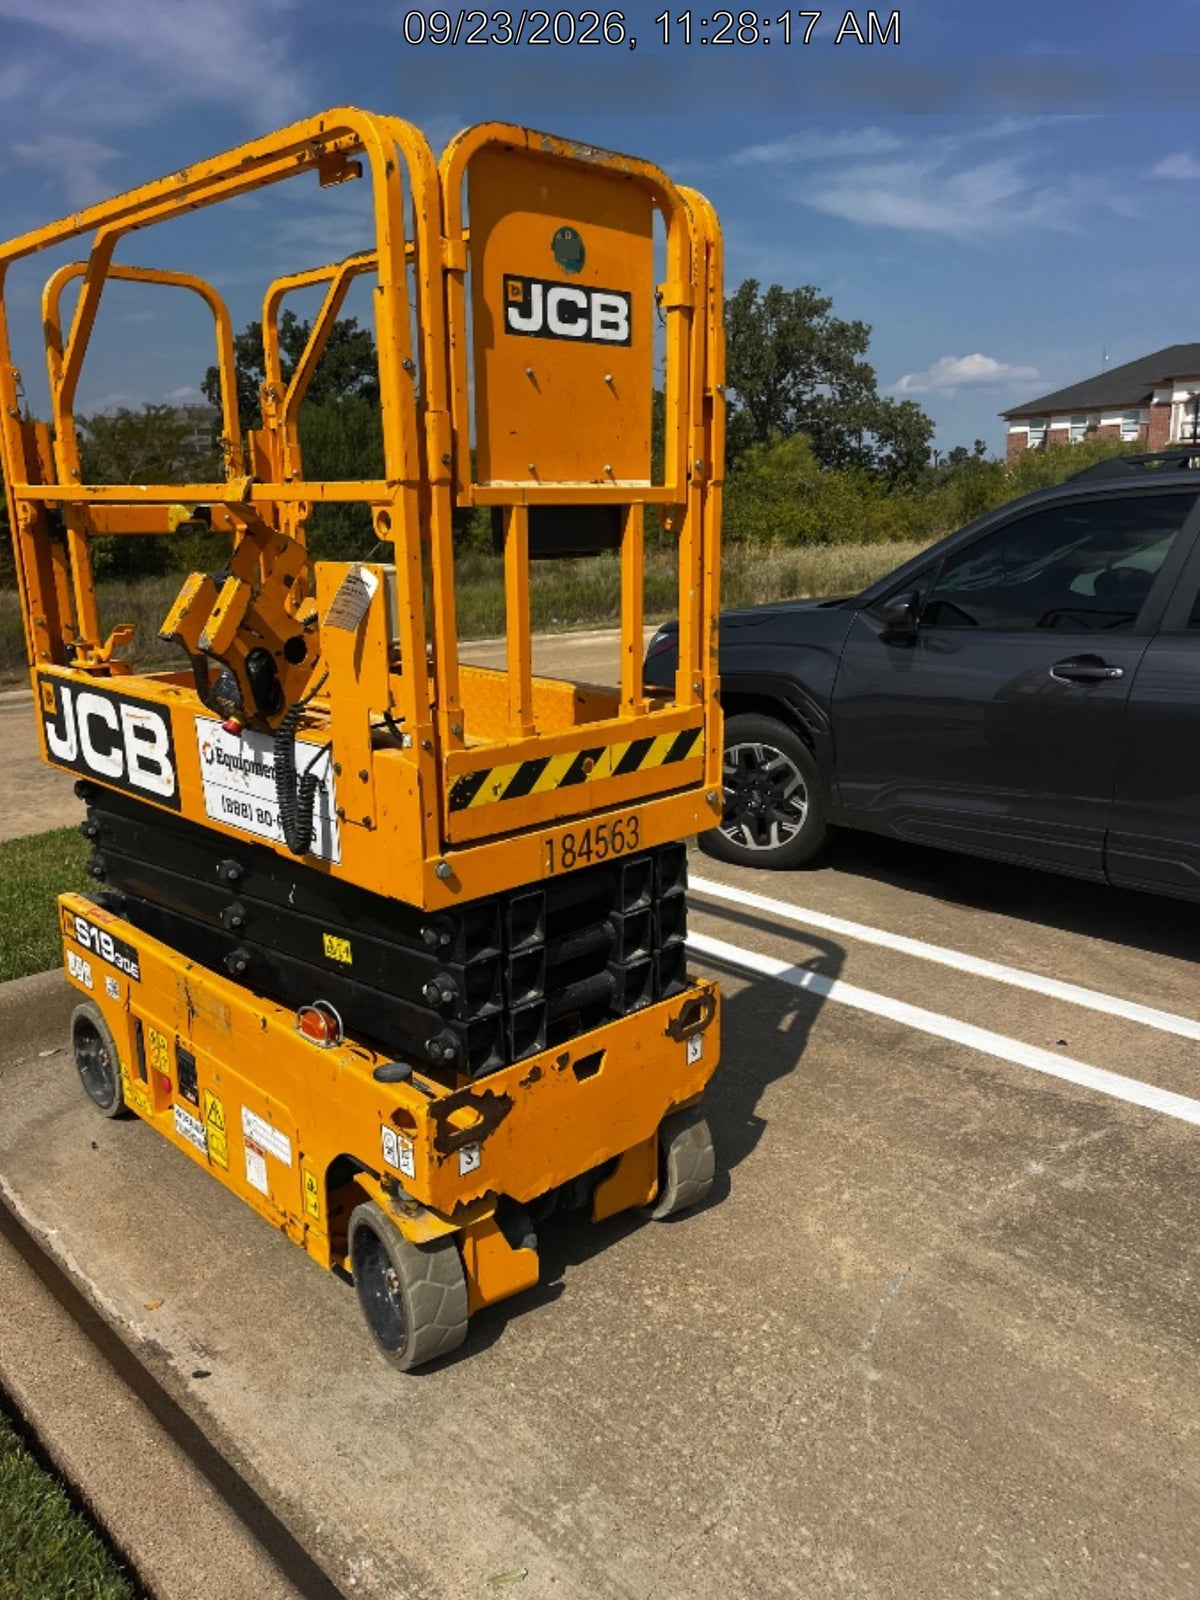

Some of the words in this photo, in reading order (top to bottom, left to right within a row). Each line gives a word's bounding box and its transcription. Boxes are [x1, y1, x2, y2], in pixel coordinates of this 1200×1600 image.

[507, 283, 630, 342] JCB
[46, 686, 175, 798] JCB
[215, 746, 278, 781] Equipmen
[221, 794, 253, 823] (888)
[544, 815, 640, 875] 184563
